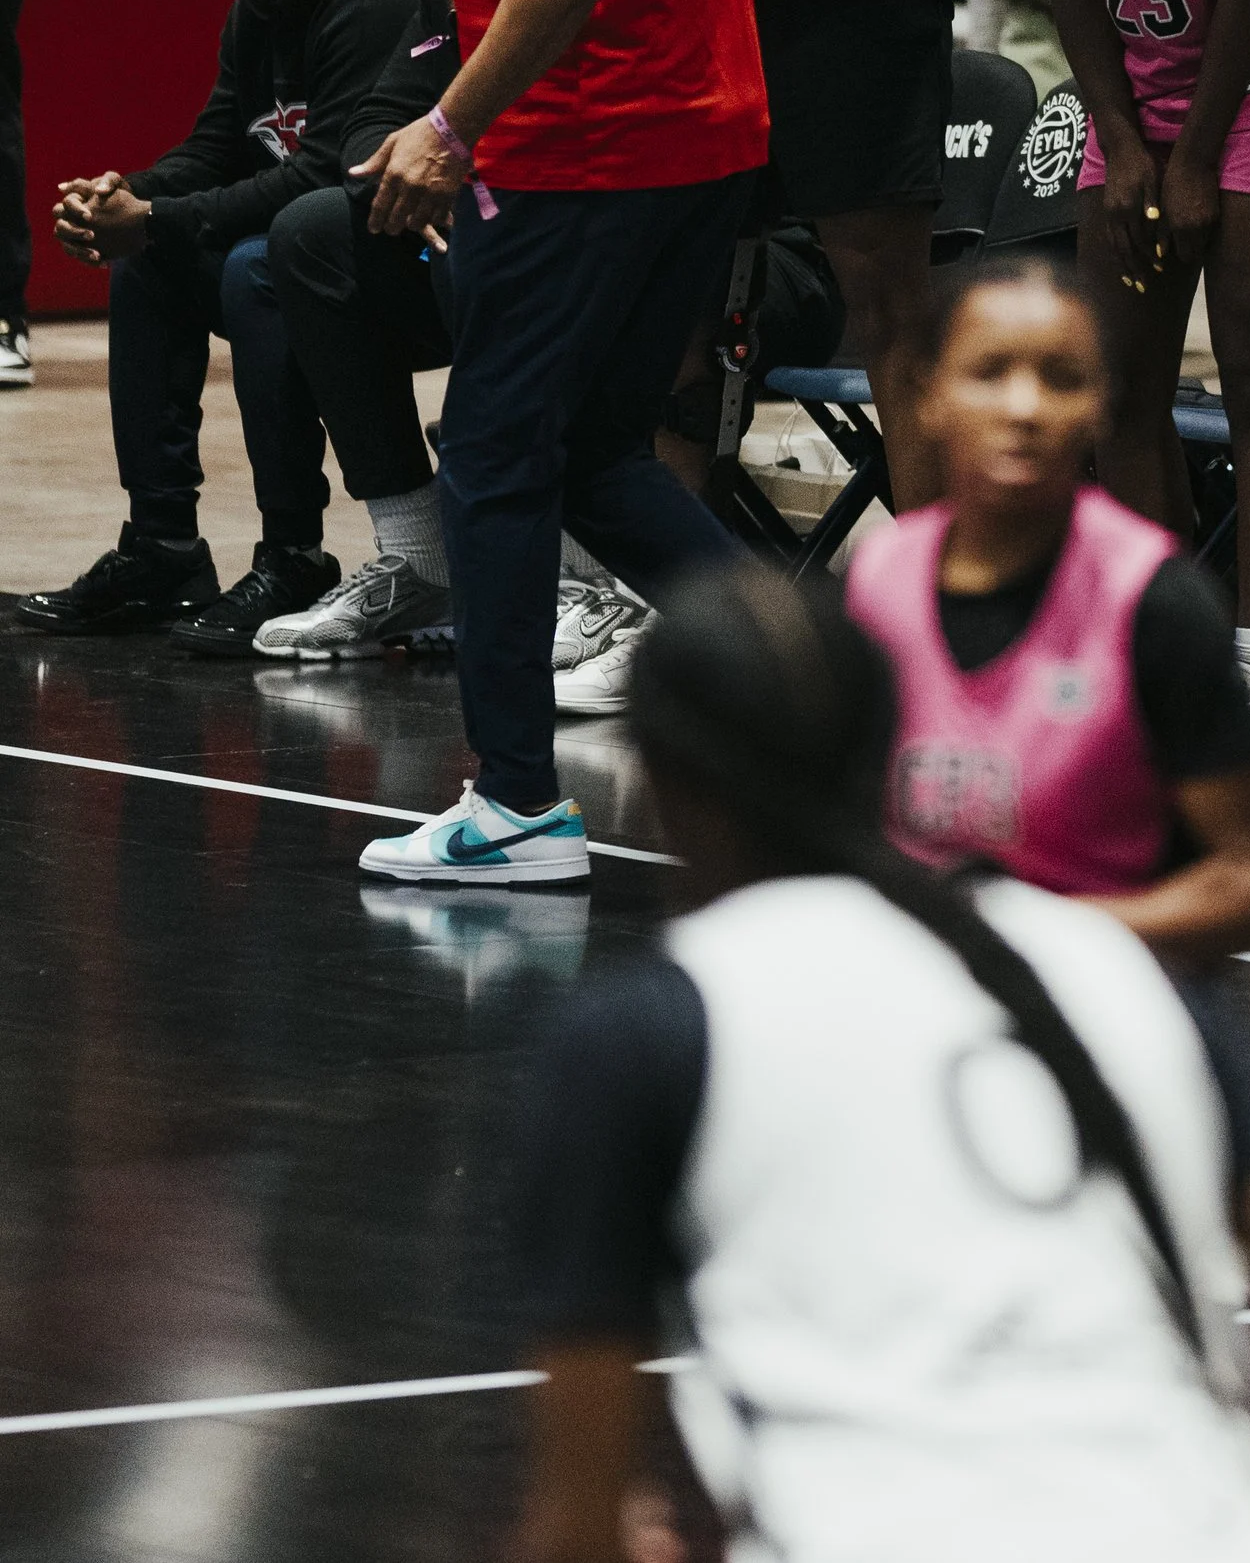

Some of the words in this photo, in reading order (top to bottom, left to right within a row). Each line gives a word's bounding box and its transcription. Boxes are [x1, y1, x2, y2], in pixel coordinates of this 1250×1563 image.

[945, 120, 993, 158] ICK'S
[1020, 114, 1042, 155] NIKE
[1043, 93, 1087, 141] NATIONALS
[1033, 127, 1071, 155] EYBL
[1033, 180, 1061, 198] 2025
